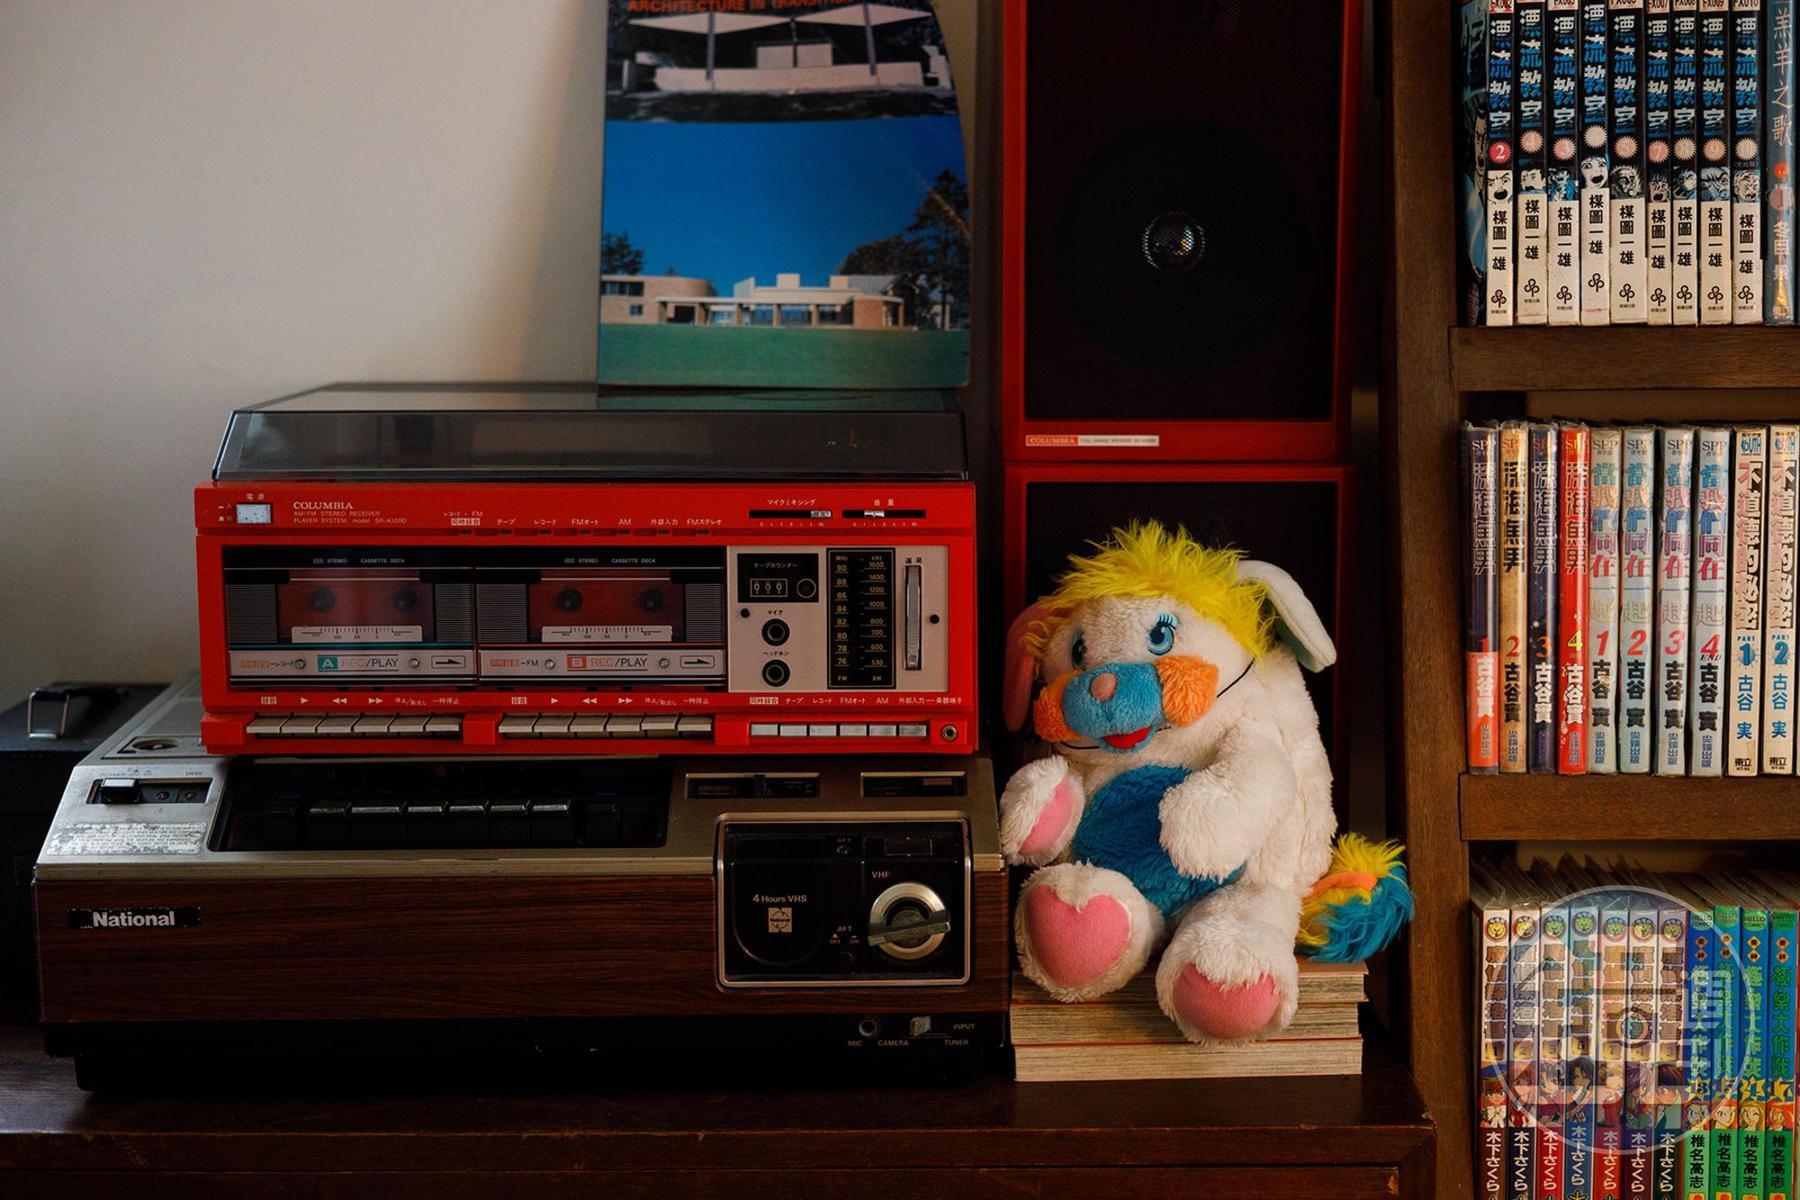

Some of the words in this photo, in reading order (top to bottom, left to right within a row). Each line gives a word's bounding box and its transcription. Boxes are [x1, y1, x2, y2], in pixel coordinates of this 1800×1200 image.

[1772, 8, 1792, 146] 羔羊之歌
[1029, 436, 1076, 445] COLUMBIA
[1702, 440, 1727, 451] SPP
[292, 501, 353, 510] COLUMBIA
[496, 518, 516, 526] テープ
[534, 518, 557, 526] レコード
[571, 518, 600, 526] FMオート
[687, 518, 722, 526] FMステレオ
[837, 564, 847, 572] 90
[1479, 637, 1489, 653] 1
[1506, 636, 1520, 657] 2
[1536, 636, 1552, 658] 3
[1568, 630, 1583, 652] 4
[1596, 631, 1610, 656] 1
[1627, 630, 1647, 656] 2
[1664, 630, 1685, 656] 3
[1701, 634, 1721, 655] 4
[321, 658, 335, 668] A
[341, 657, 399, 668] REC/PLAY
[591, 657, 647, 668] REC/PLAY
[1739, 643, 1751, 666] 1
[1774, 642, 1788, 665] 2
[753, 894, 760, 902] 4
[761, 895, 787, 903] Hours
[788, 895, 807, 903] VHS
[92, 911, 175, 926] National
[1486, 1131, 1501, 1191] 木下さくら
[1514, 1131, 1529, 1190] 木下さくら
[1543, 1131, 1558, 1190] 木下さくら
[1603, 1131, 1618, 1190] 木下さくら
[1631, 1133, 1646, 1192] 木下さくら
[1660, 1133, 1675, 1192] 木下さくら
[1690, 1134, 1704, 1188] 椎名高志
[1717, 1133, 1731, 1187] 椎名高志
[1744, 1134, 1758, 1188] 椎名高志
[1771, 1134, 1786, 1188] 椎名高志
